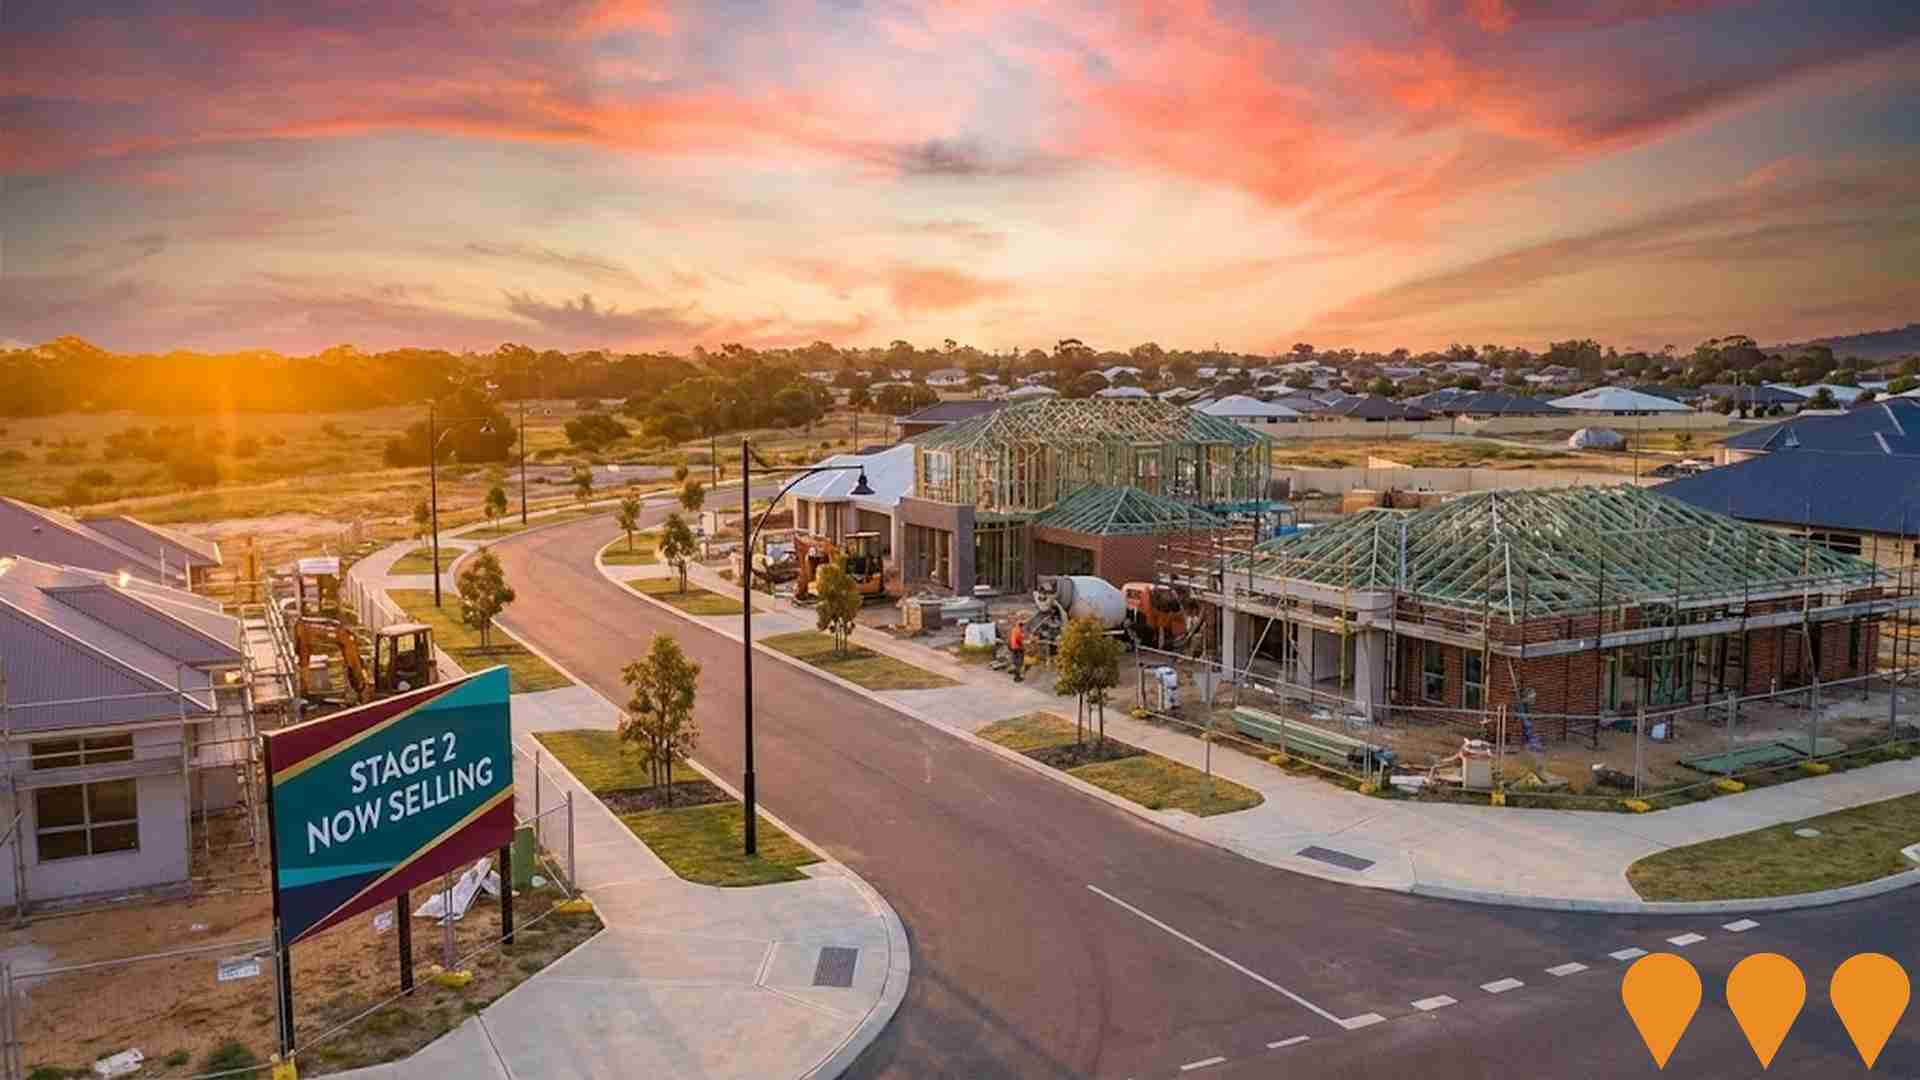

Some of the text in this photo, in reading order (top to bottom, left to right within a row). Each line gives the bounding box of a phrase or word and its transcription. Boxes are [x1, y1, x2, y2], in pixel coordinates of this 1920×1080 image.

[351, 732, 457, 794] STAGE 2
[306, 757, 493, 854] NOW SELLING
